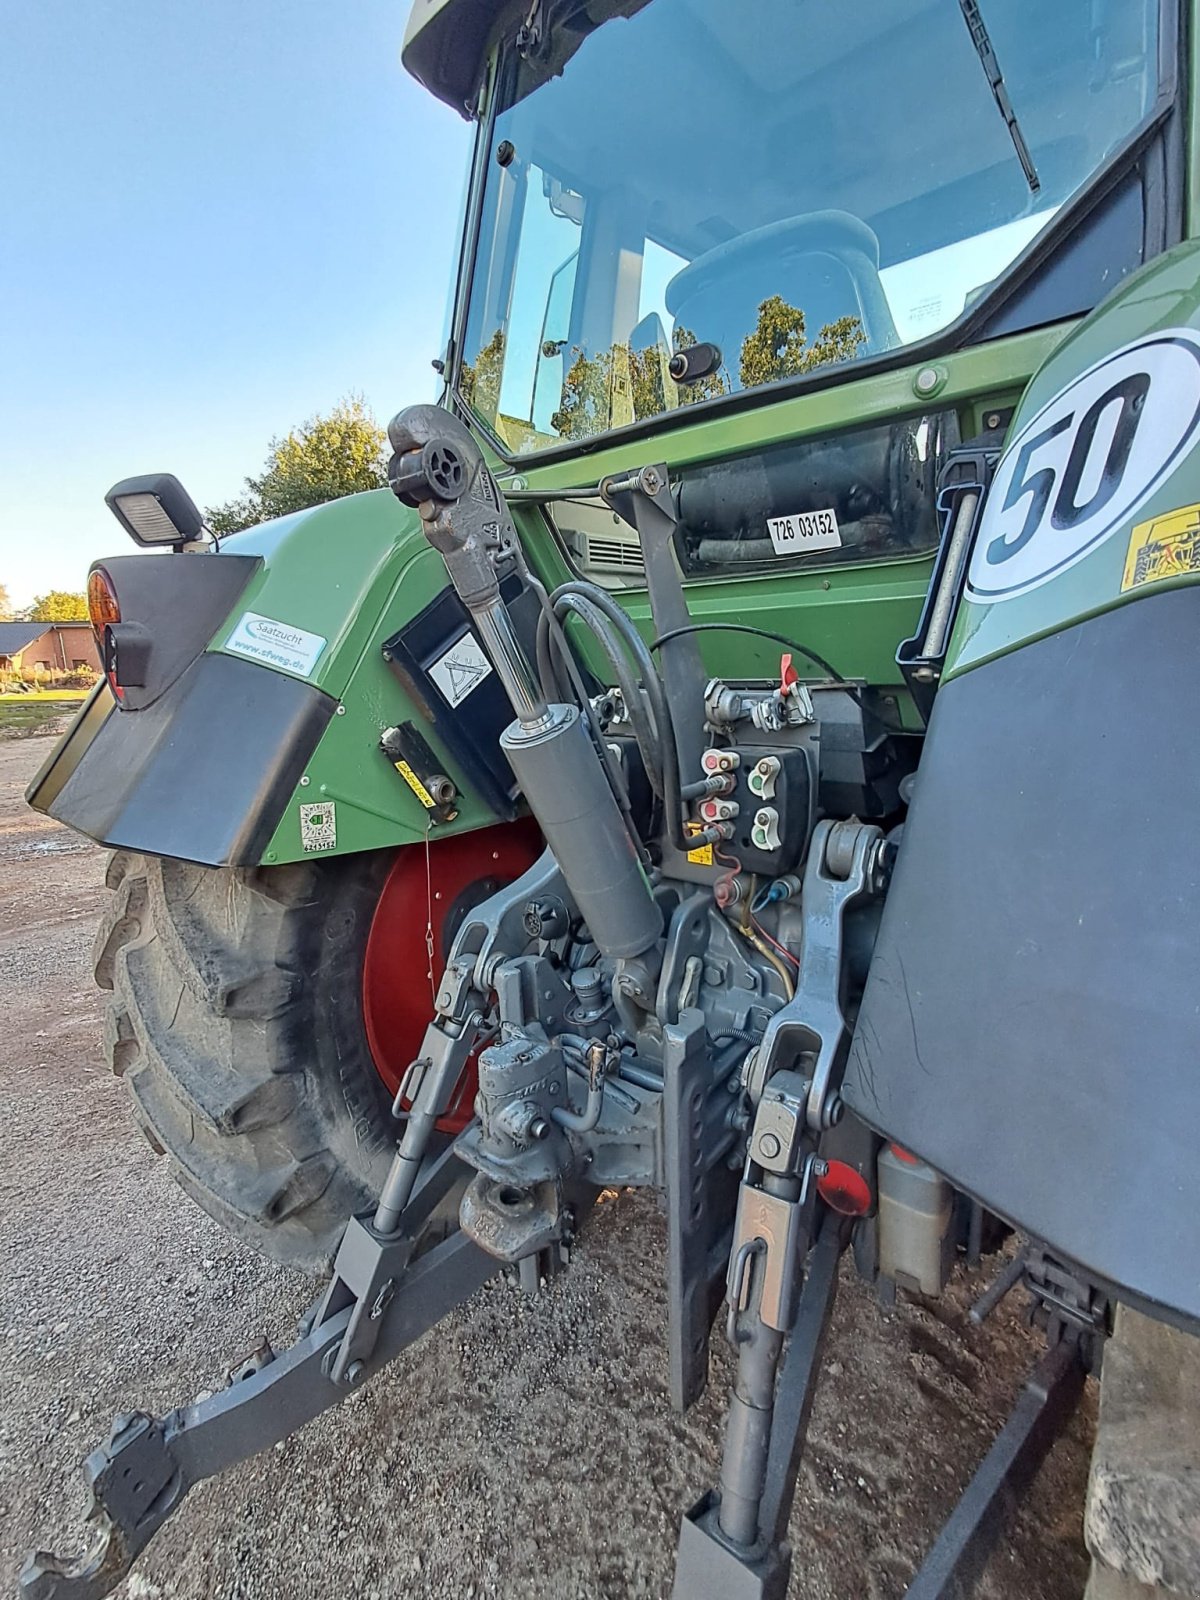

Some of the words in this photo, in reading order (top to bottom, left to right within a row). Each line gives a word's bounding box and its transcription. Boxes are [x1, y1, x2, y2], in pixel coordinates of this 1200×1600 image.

[986, 372, 1152, 566] 50
[773, 519, 795, 541] 726
[798, 513, 834, 537] 03152
[256, 622, 303, 645] Saatzucht
[234, 640, 305, 671] www.sfweg.de
